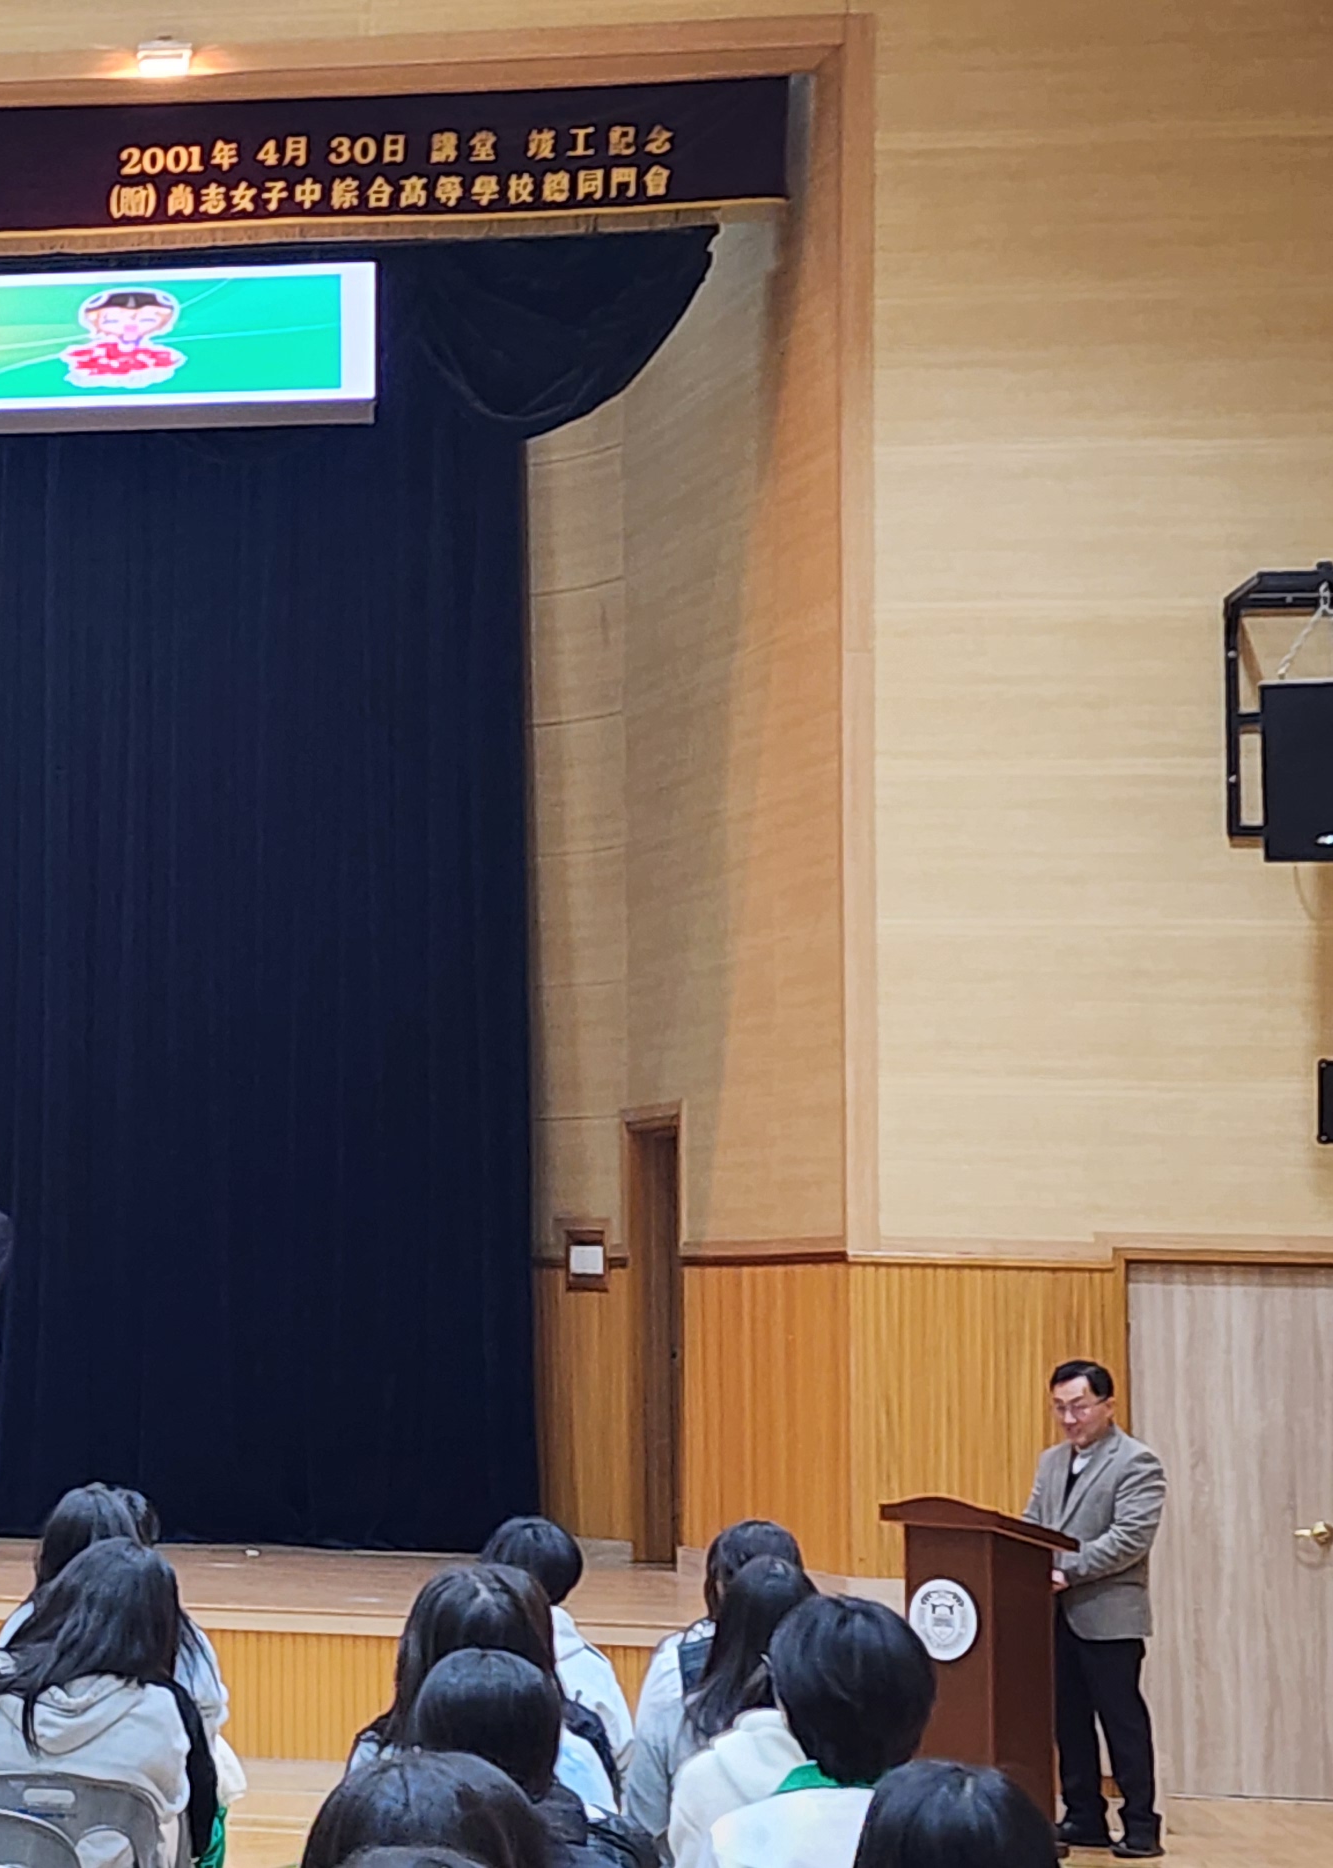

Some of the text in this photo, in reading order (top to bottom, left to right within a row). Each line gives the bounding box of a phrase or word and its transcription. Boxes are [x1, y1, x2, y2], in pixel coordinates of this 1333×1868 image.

[120, 138, 239, 176] 2001年
[256, 135, 310, 167] 4月
[328, 133, 406, 165] 30日
